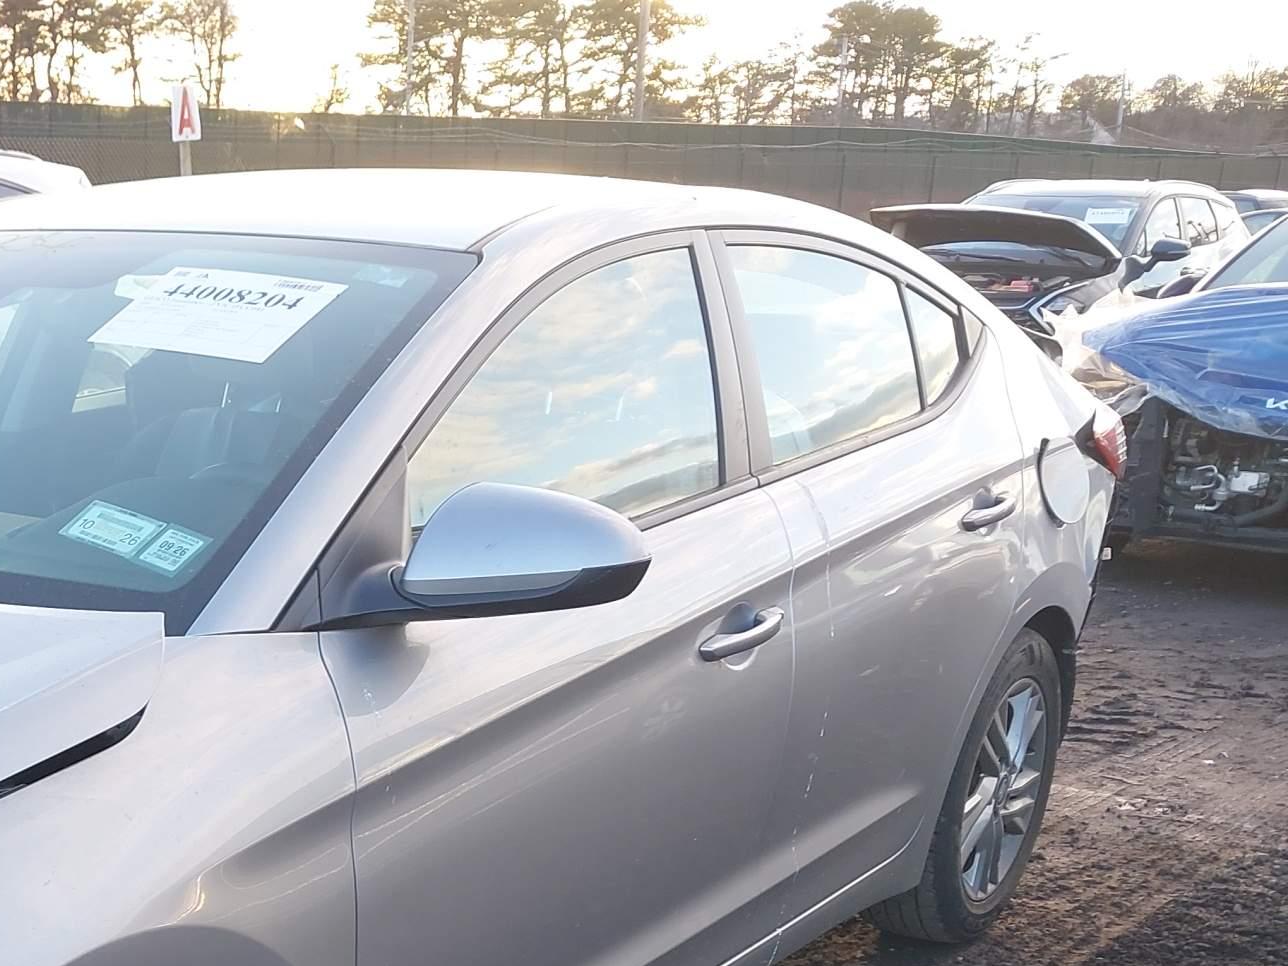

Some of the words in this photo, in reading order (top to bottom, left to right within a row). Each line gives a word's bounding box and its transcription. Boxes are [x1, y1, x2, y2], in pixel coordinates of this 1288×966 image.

[178, 86, 196, 136] A
[163, 283, 305, 310] 44008204
[79, 518, 95, 530] 10
[119, 532, 139, 546] 26
